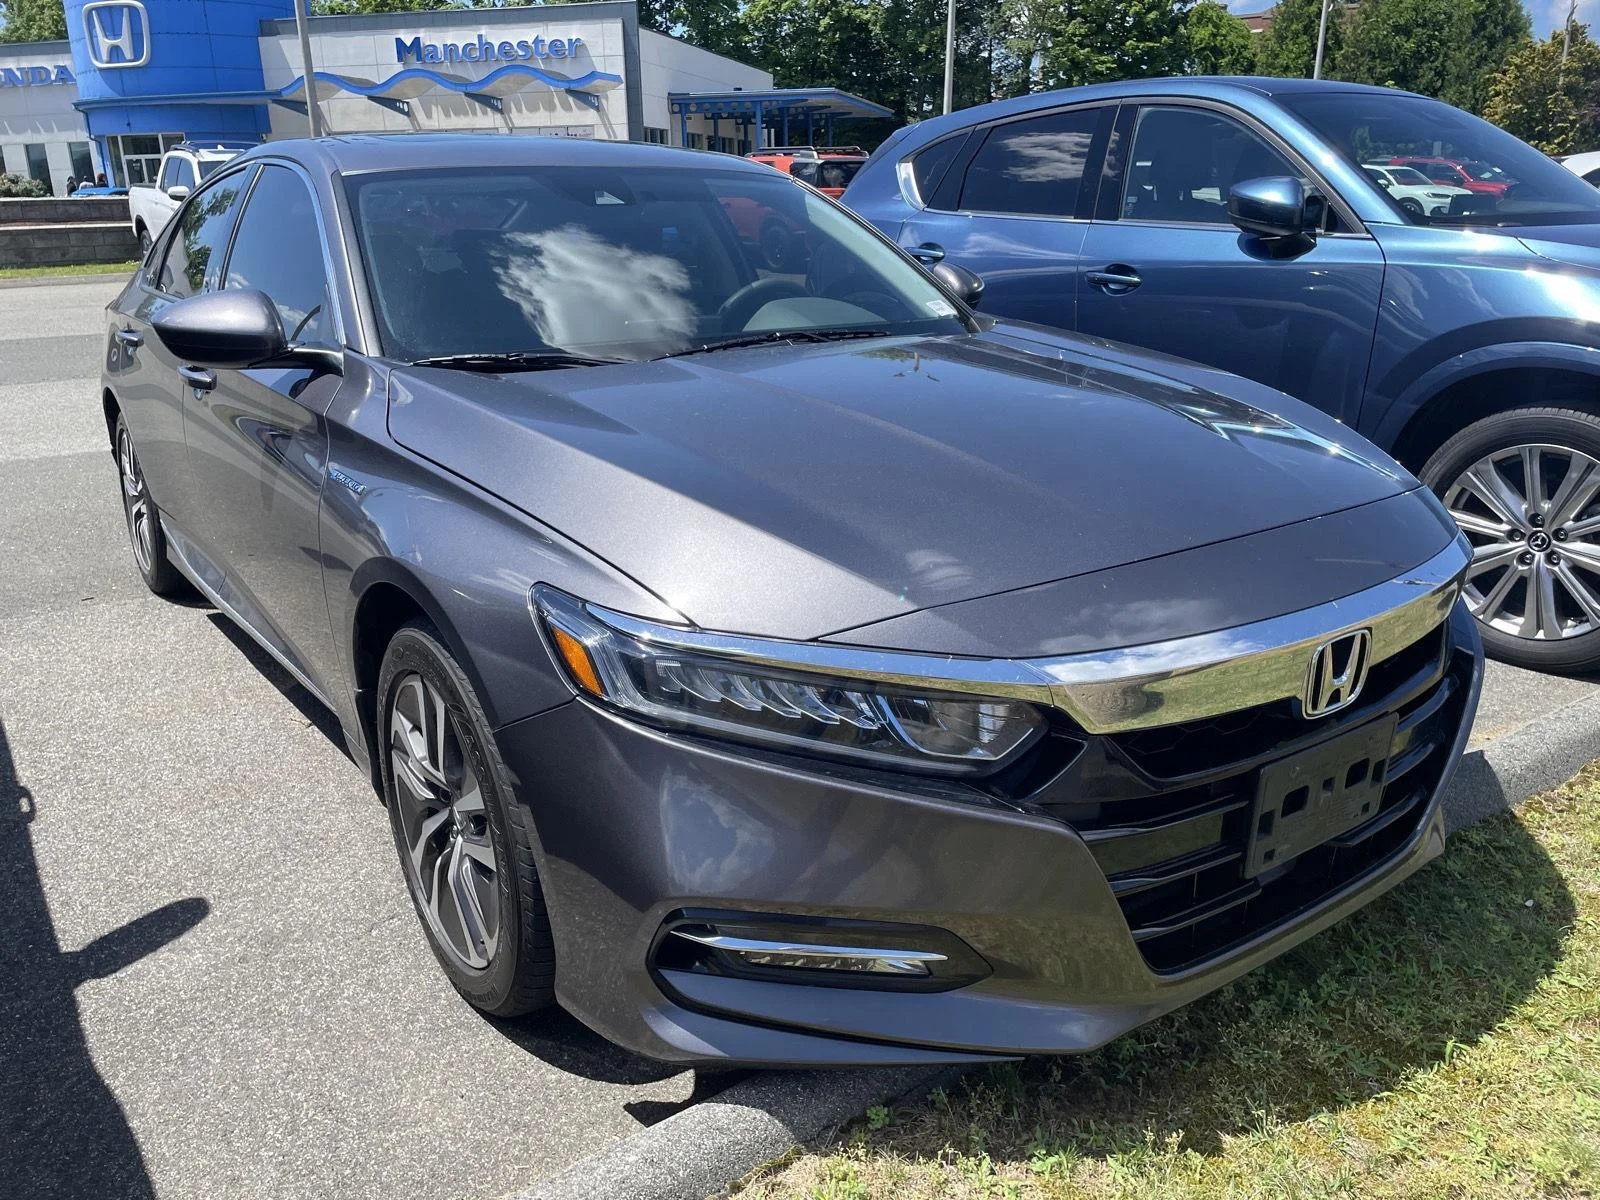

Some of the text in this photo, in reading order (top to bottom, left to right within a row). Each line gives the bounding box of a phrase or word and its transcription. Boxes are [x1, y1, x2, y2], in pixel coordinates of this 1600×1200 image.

[395, 34, 583, 63] Manchester
[0, 64, 76, 88] NDA
[1316, 631, 1362, 712] H
